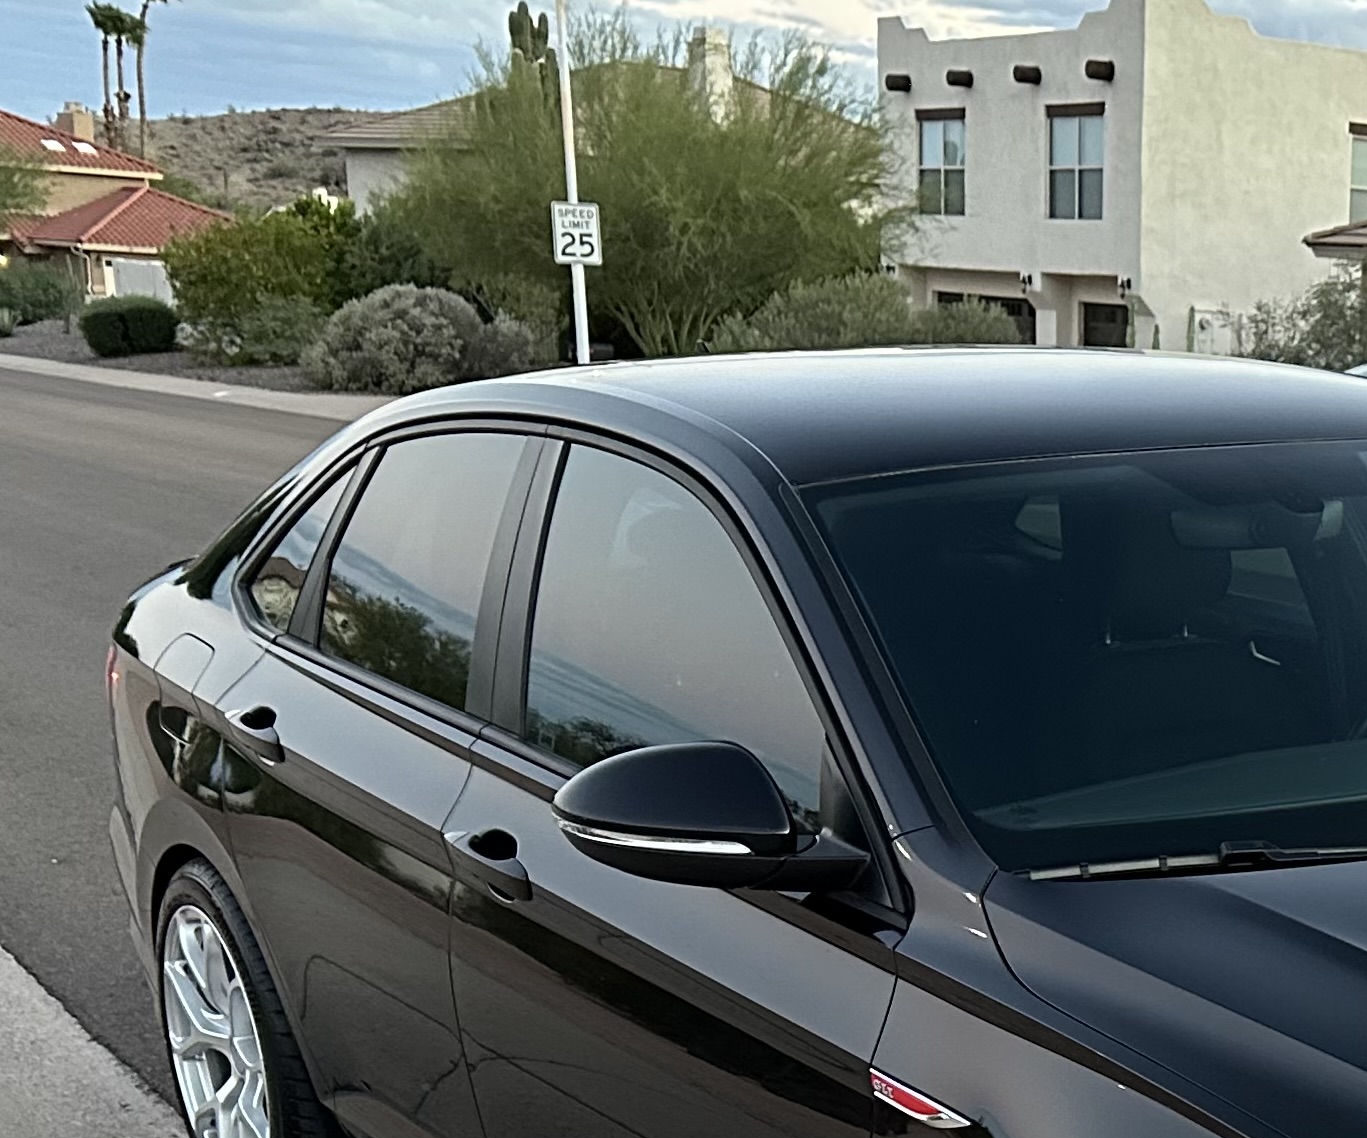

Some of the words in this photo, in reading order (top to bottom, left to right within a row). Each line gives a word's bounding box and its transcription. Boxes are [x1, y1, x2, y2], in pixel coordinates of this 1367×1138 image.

[558, 208, 594, 219] SPEED
[561, 220, 590, 229] LIMIT
[561, 232, 595, 258] 25
[873, 1080, 895, 1099] GLI
